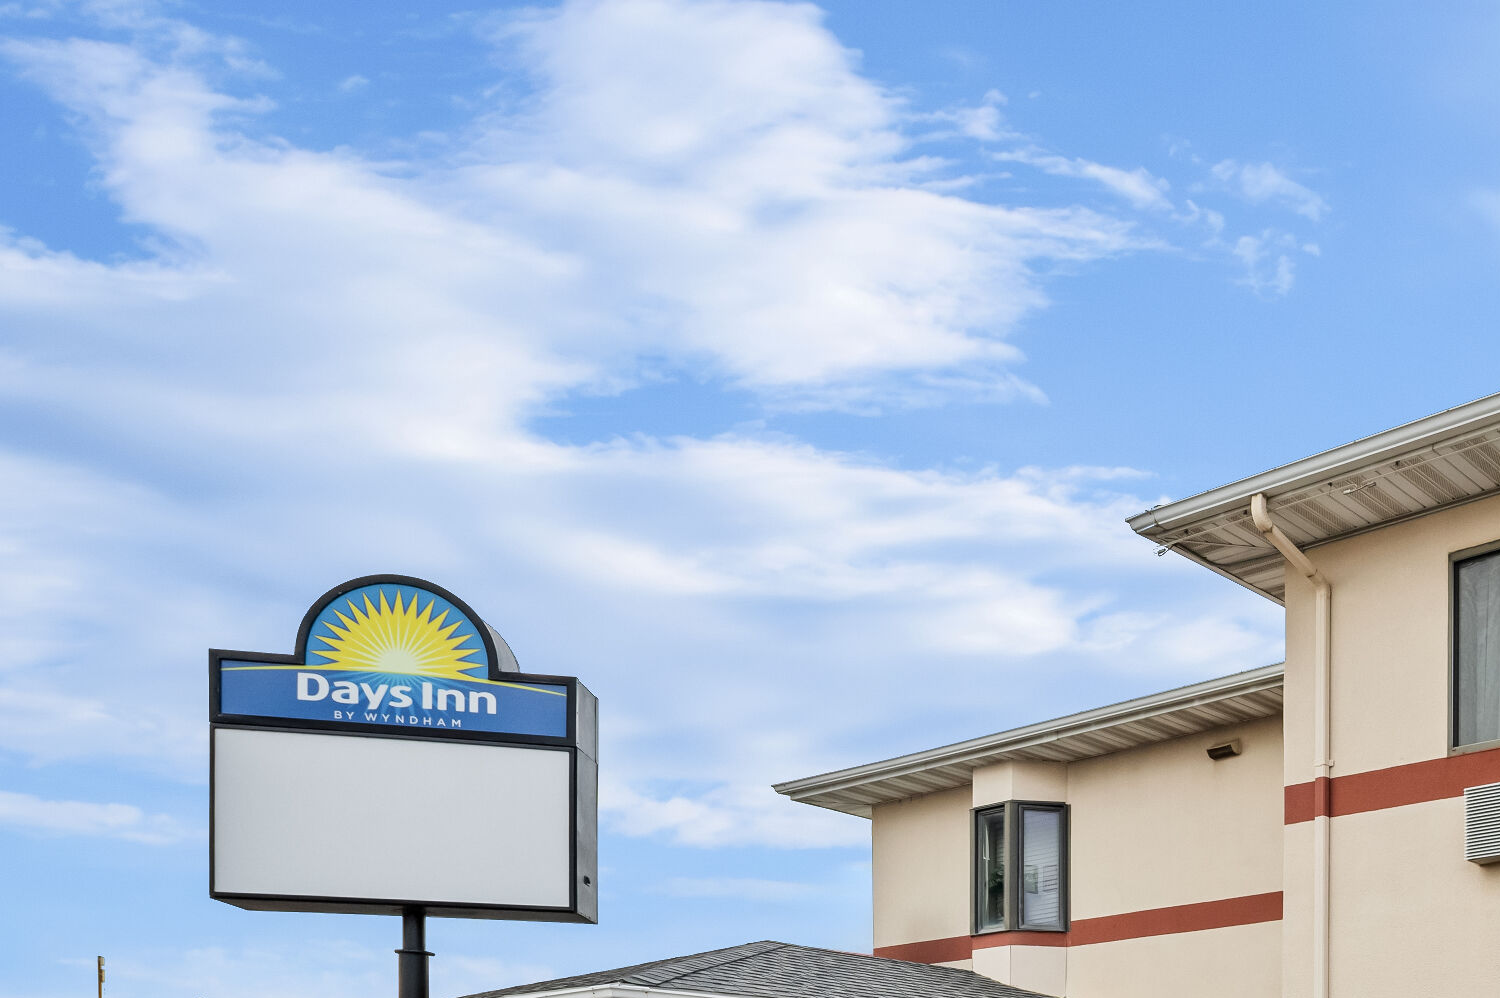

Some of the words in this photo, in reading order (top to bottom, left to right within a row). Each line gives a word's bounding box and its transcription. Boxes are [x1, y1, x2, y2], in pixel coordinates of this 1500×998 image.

[297, 672, 413, 710] Days
[422, 682, 497, 714] Inn
[334, 711, 354, 720] BY
[365, 712, 462, 728] WYNDHAM
